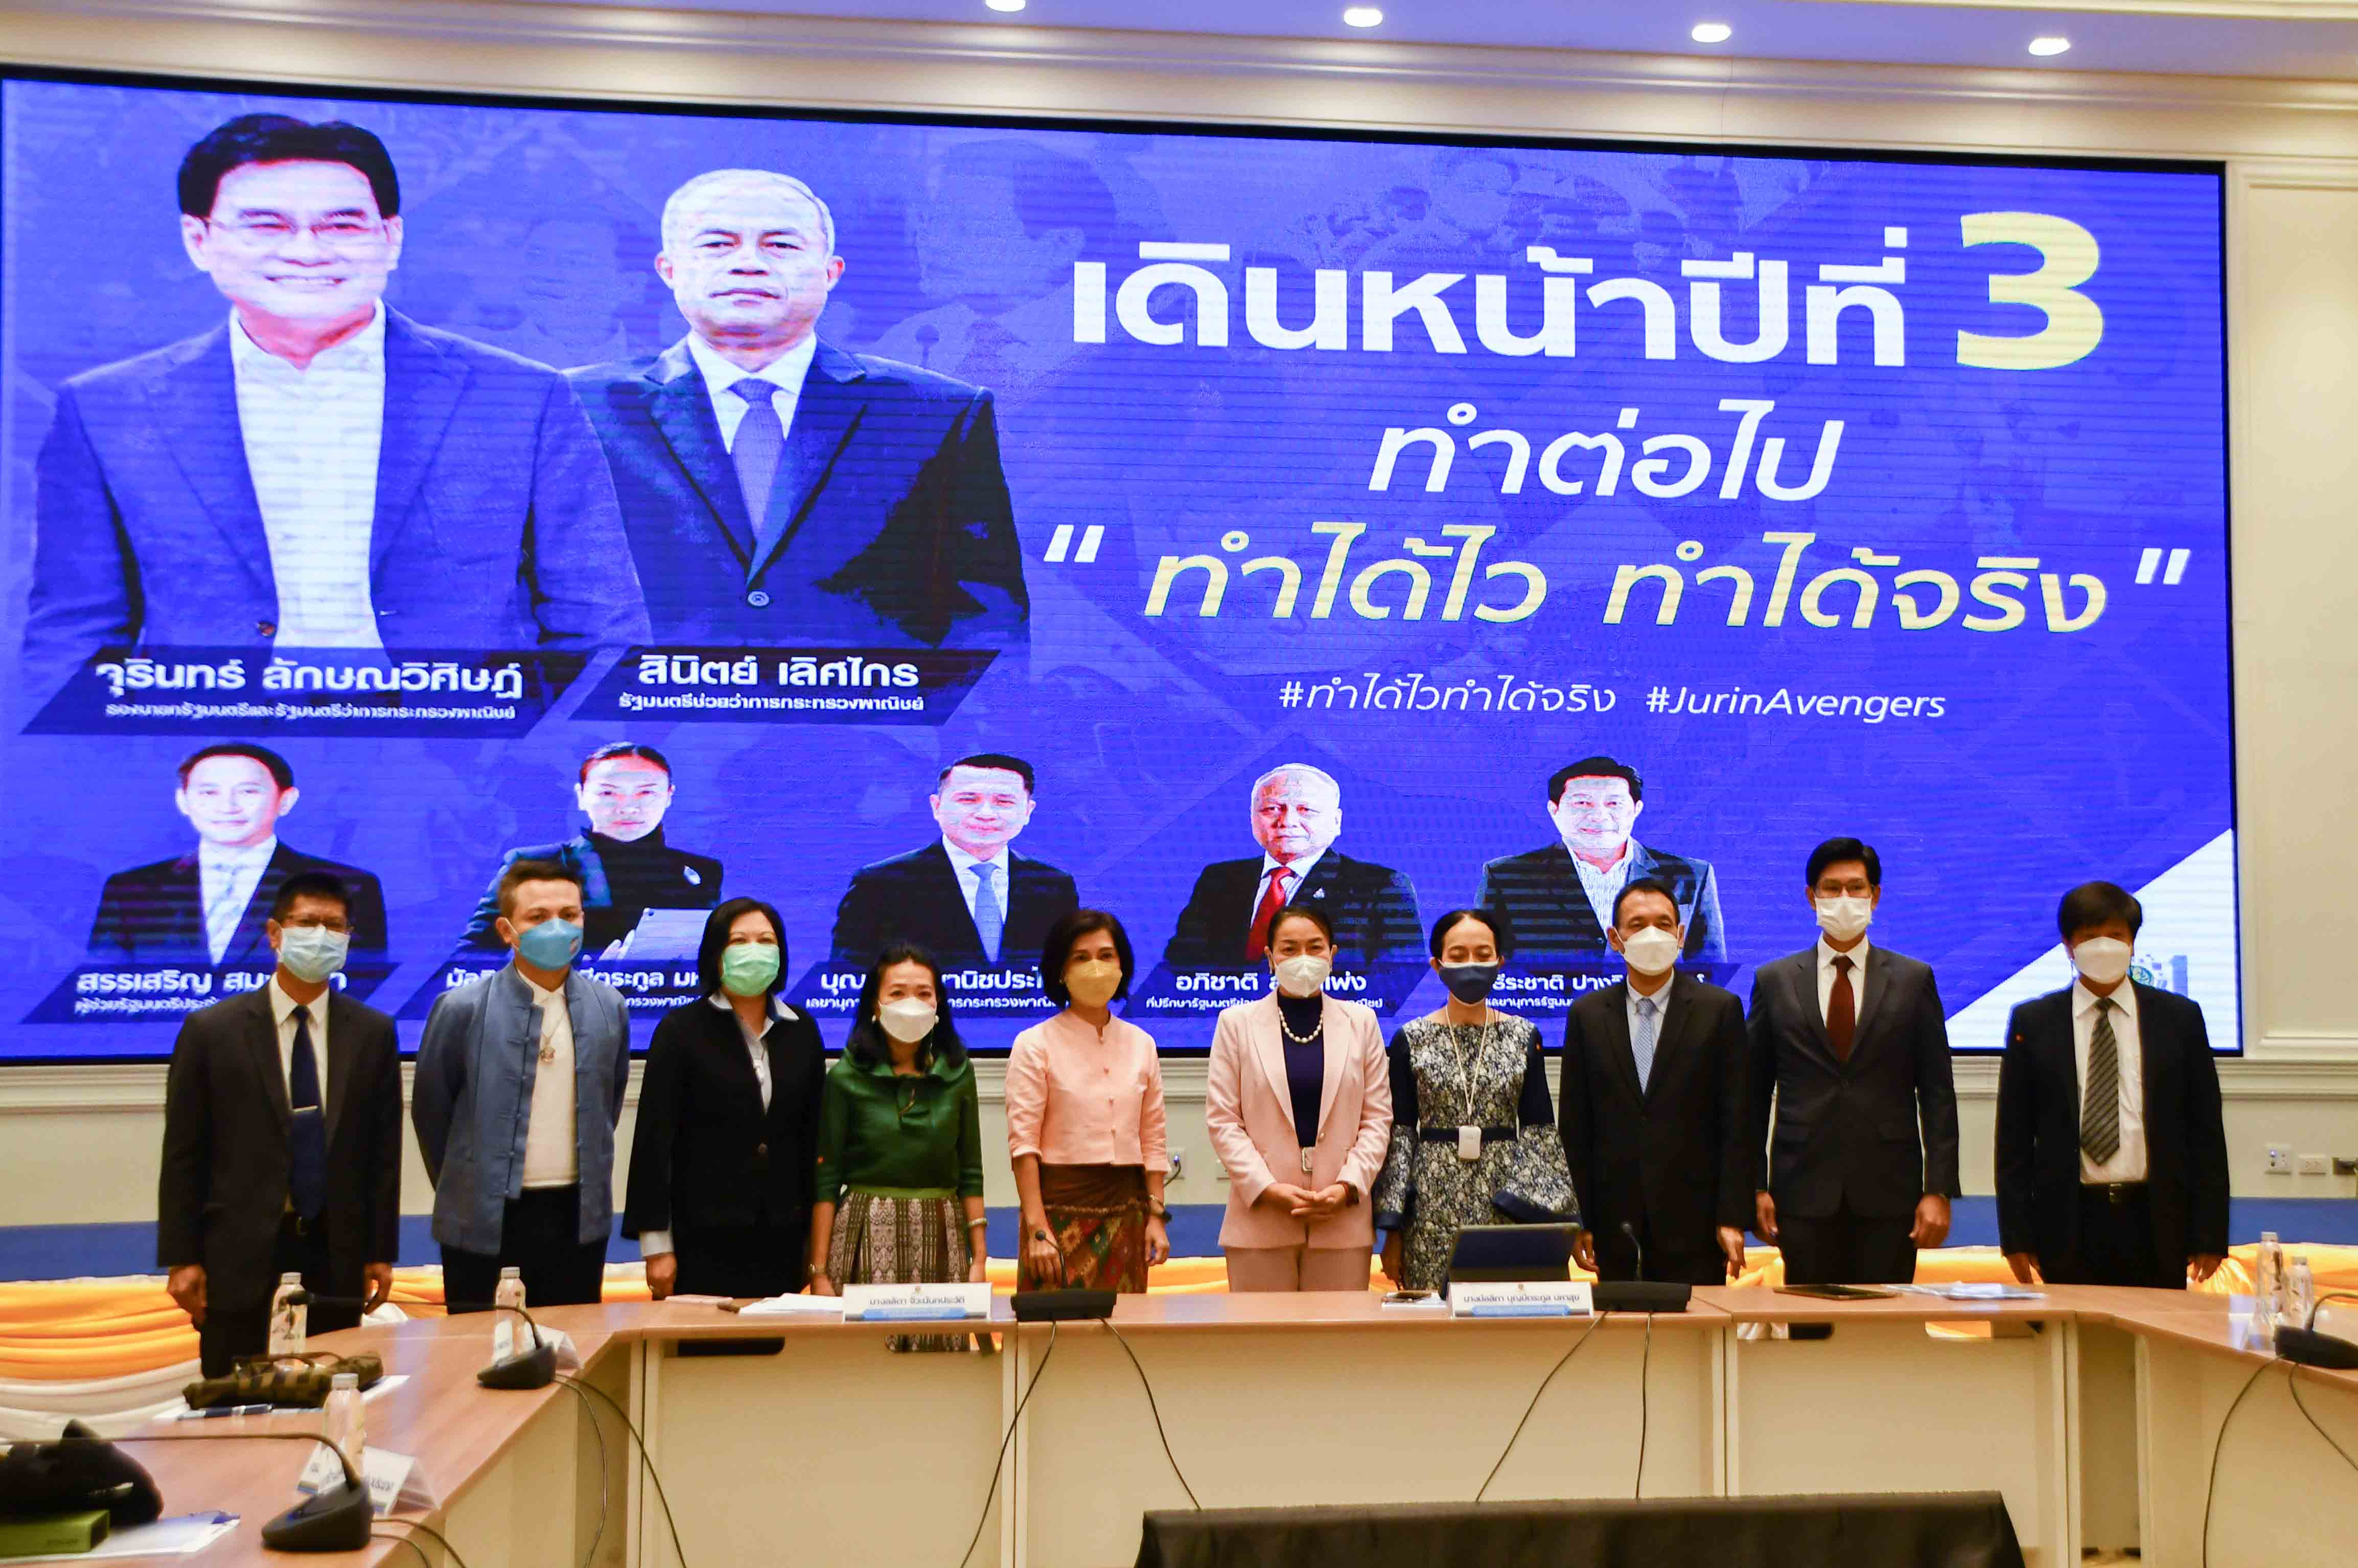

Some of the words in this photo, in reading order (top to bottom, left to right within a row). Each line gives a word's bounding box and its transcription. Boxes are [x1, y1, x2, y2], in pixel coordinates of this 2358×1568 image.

[1072, 227, 1908, 367] เดินหน้าปีที่
[1956, 211, 2105, 370] 3
[1368, 399, 1845, 501] ทำต่อไป
[1144, 522, 1547, 623] ทำได้ไว
[1603, 532, 2108, 633] ทำได้จริง
[96, 658, 246, 696] จุรินทร์
[639, 654, 757, 685] สินิตย์
[779, 656, 919, 686] เลิศไกร
[1279, 672, 1616, 713] #ทำได้ไวทำได้จริง
[1645, 687, 1946, 723] #JurinAvengers
[1176, 972, 1259, 991] อภิชาติ
